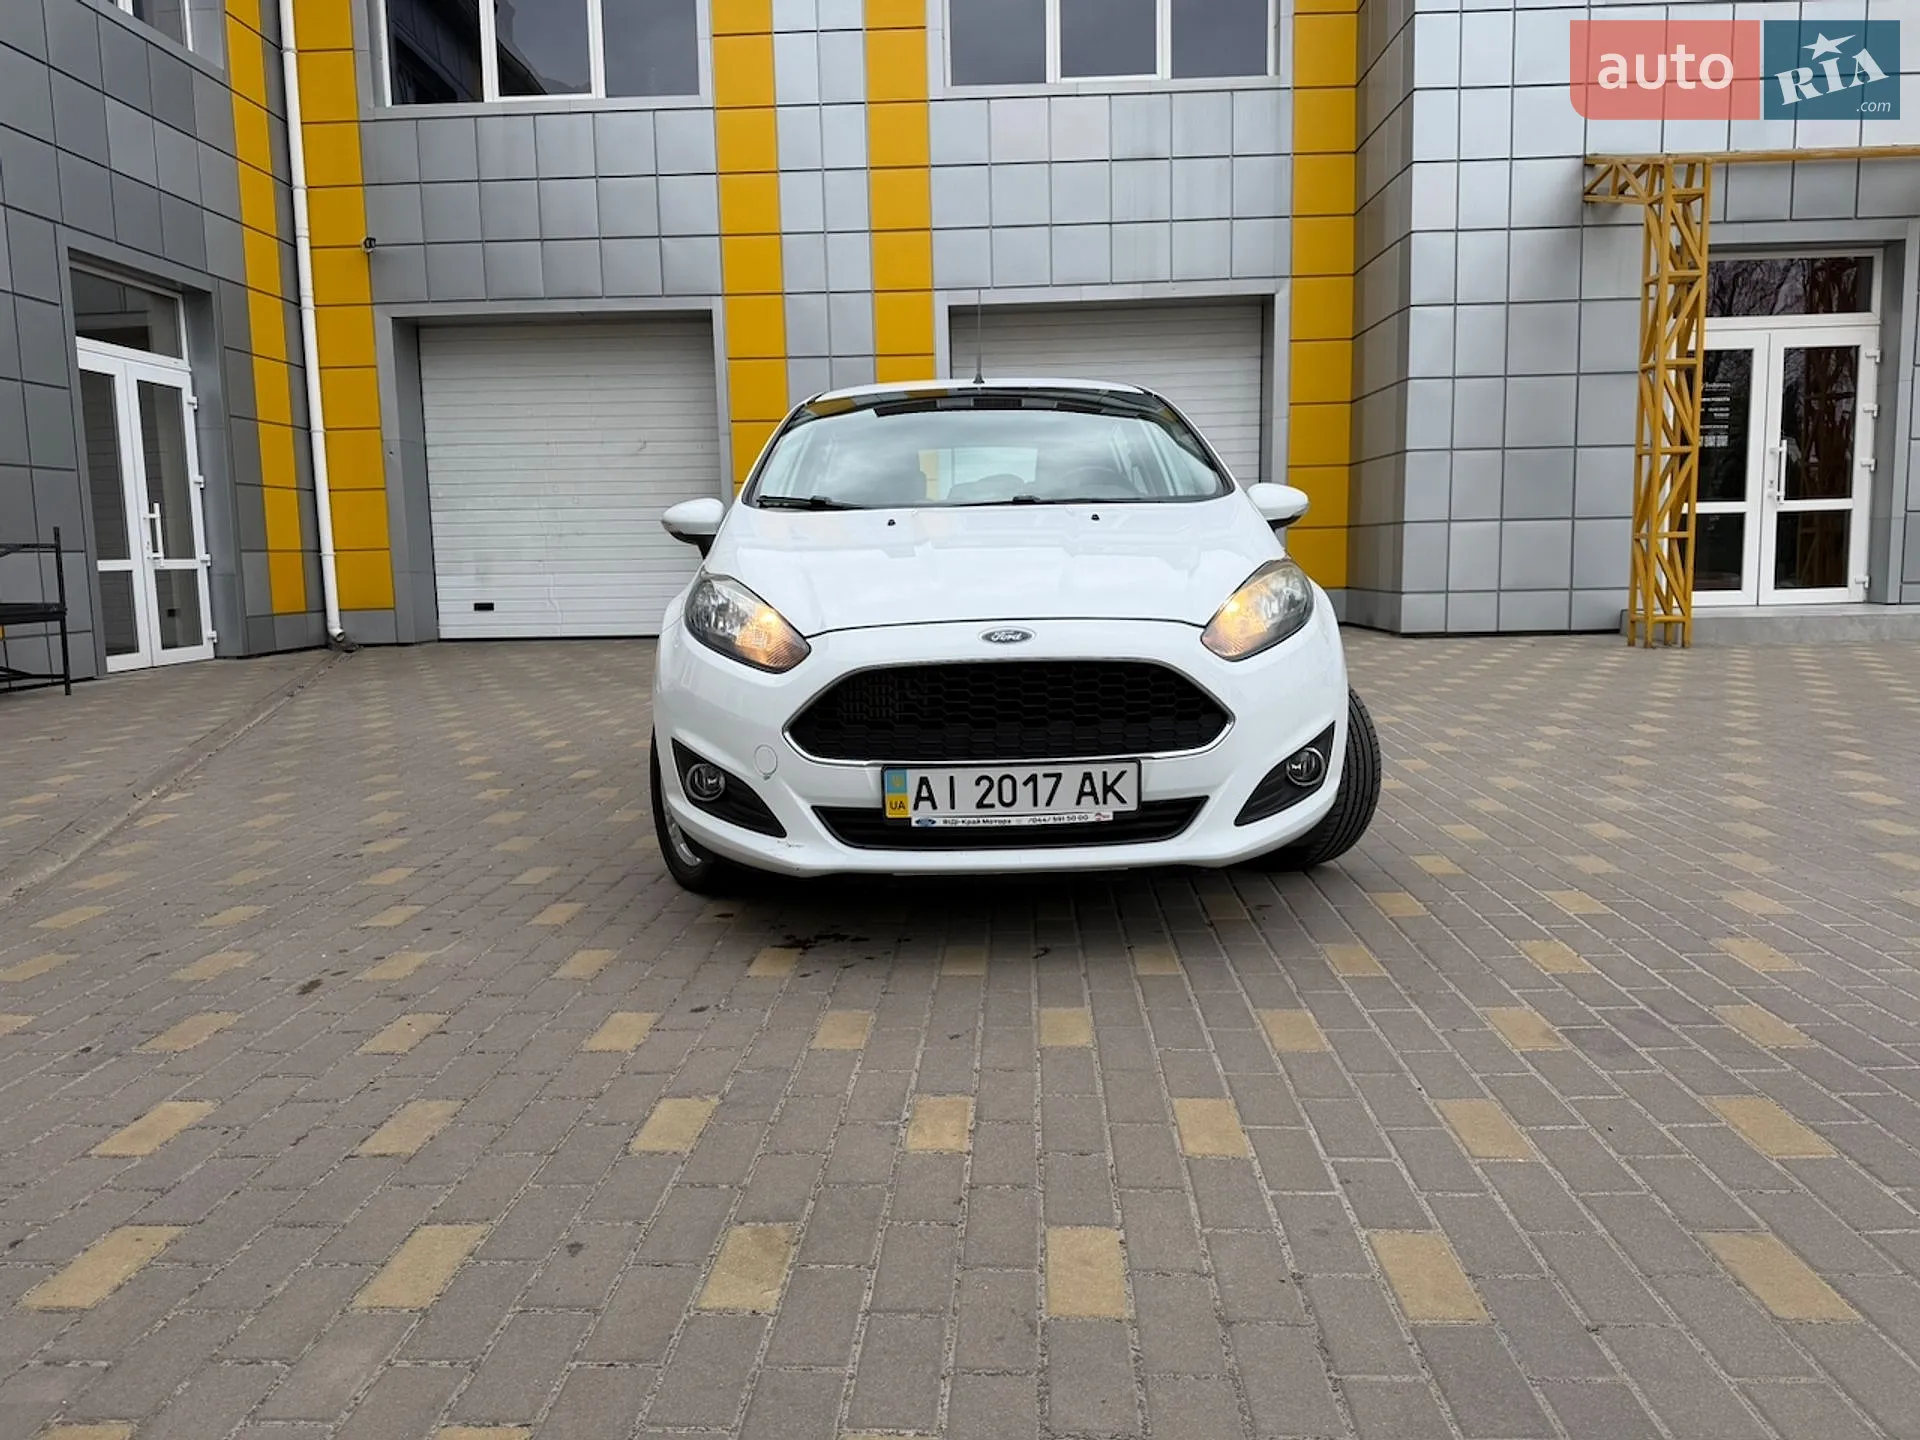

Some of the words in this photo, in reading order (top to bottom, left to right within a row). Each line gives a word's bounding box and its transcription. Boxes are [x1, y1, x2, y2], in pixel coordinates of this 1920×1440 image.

[913, 776, 956, 811] AI
[975, 772, 1063, 810] 2017
[1076, 770, 1128, 806] AK
[889, 800, 906, 811] UA
